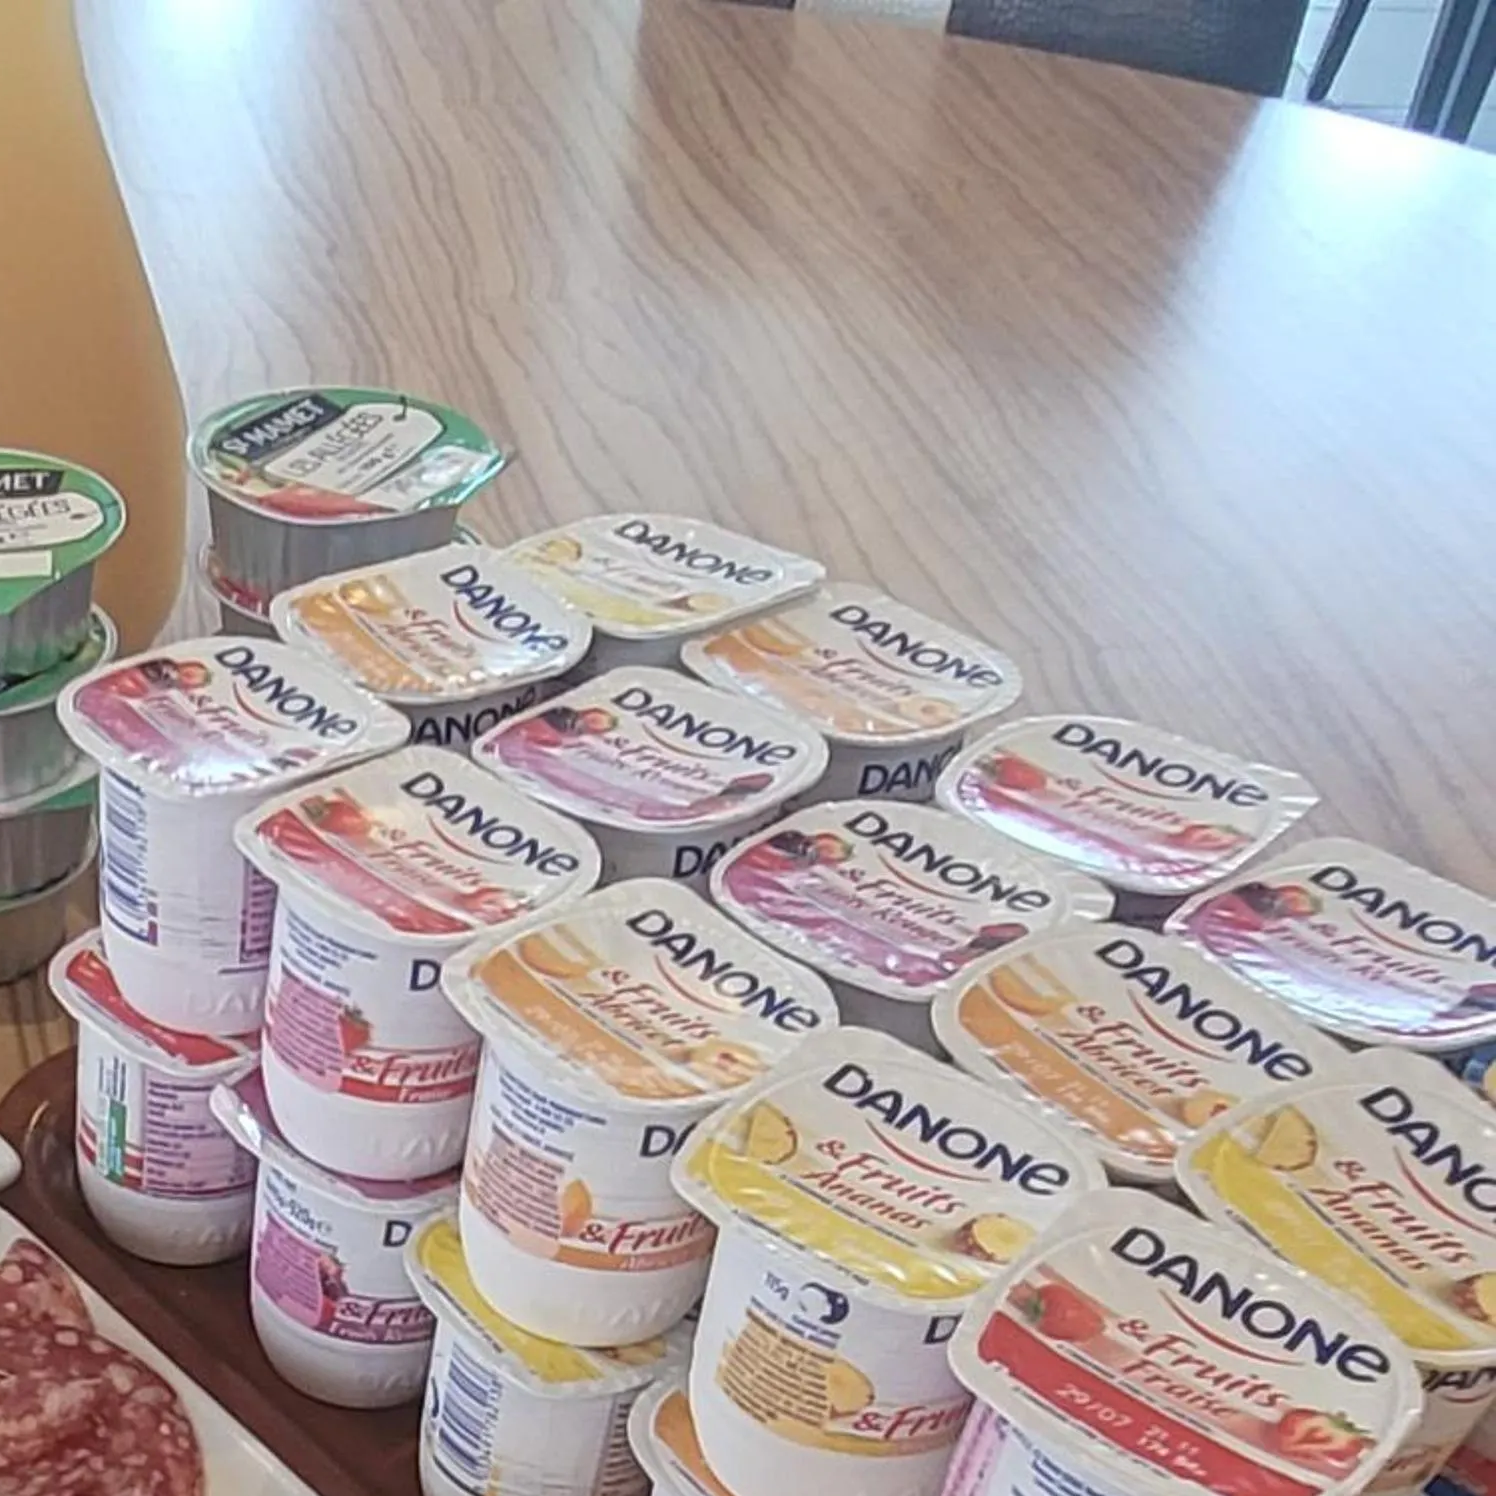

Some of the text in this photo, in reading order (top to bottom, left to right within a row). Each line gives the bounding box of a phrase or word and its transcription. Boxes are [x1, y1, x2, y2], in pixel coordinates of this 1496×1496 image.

[613, 519, 774, 585] DANONE
[440, 563, 568, 654] DANONE
[829, 605, 1003, 690] DANONE
[214, 645, 357, 740] DANONE
[610, 687, 798, 767] DANONE
[1051, 722, 1270, 807] DANONE
[400, 772, 580, 877] DANONE
[843, 812, 1053, 915] DANONE
[1309, 866, 1496, 968] DANON
[627, 909, 820, 1032] DANONE
[1095, 939, 1312, 1082] DANONE
[1093, 1021, 1211, 1089] Fruits
[822, 1063, 1071, 1196] DANONE
[1357, 1086, 1496, 1226] DANO
[802, 1165, 939, 1235] Ananas
[830, 1150, 970, 1218] Fruits
[1350, 1180, 1476, 1265] Fruits
[1306, 1187, 1432, 1271] Ananas
[1110, 1227, 1391, 1384] DANONE
[1134, 1333, 1292, 1408] Fruits
